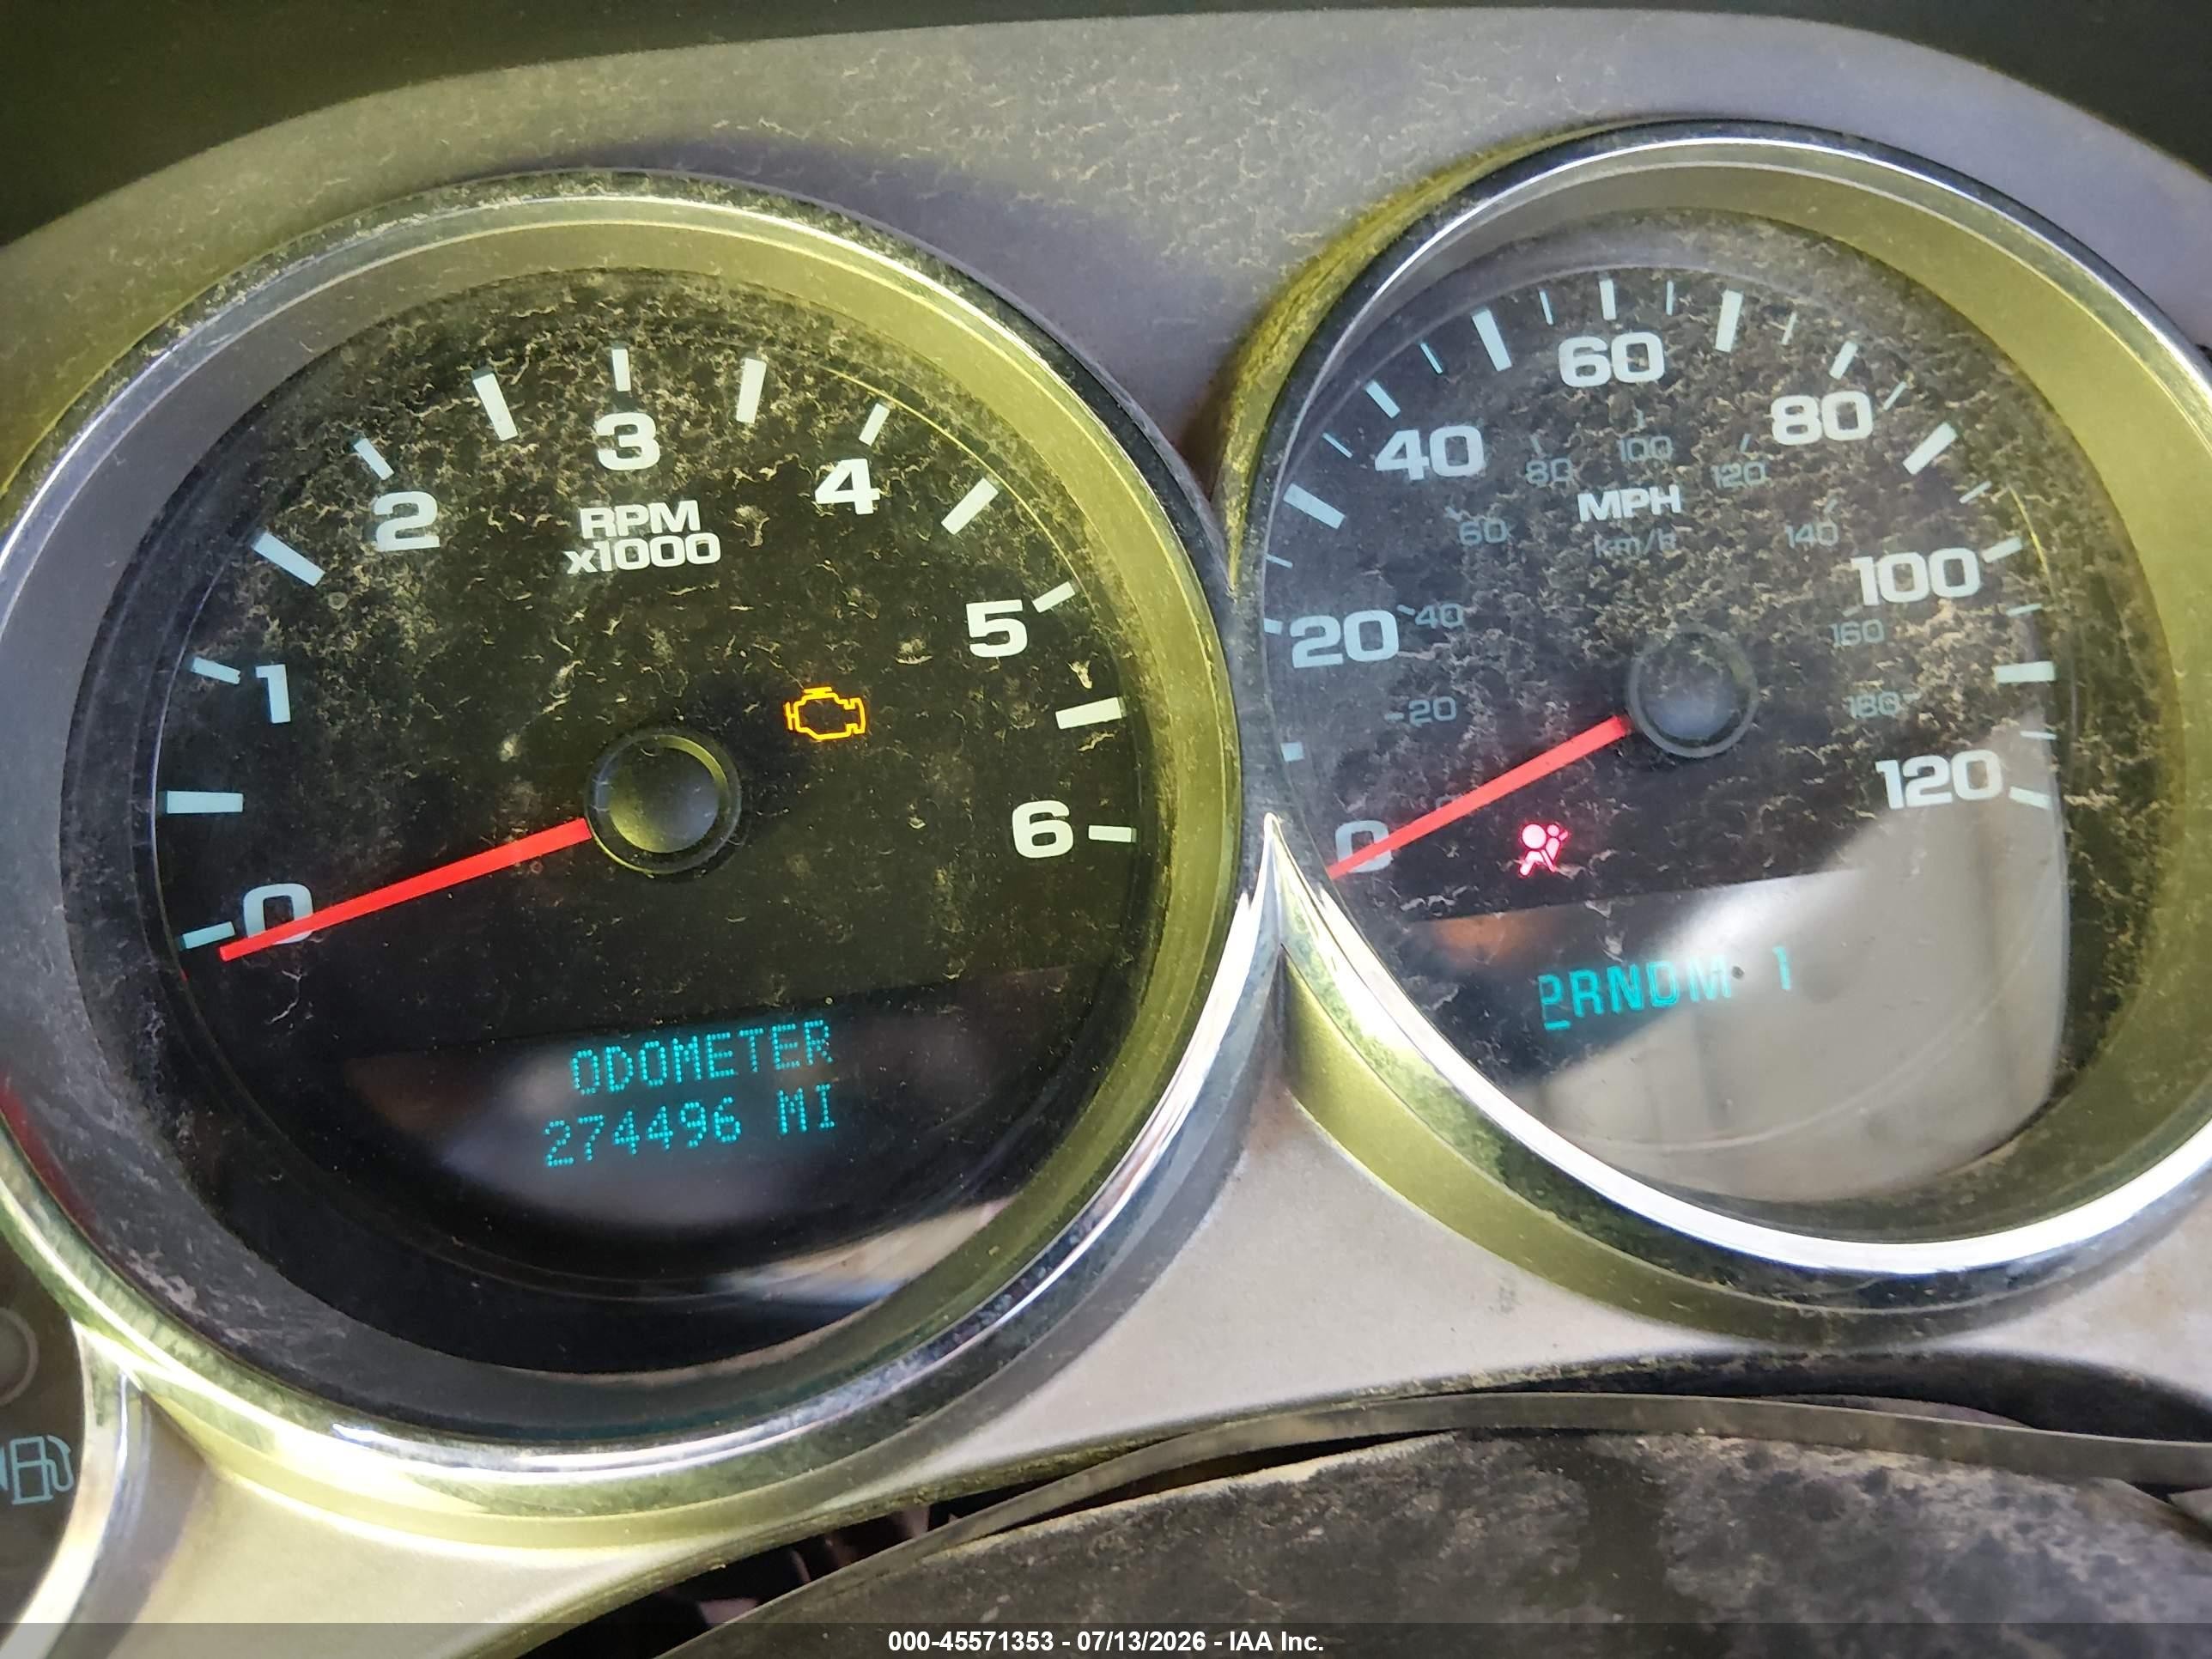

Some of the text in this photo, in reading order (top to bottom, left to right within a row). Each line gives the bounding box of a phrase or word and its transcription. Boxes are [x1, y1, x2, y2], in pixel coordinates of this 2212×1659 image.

[1559, 331, 1665, 387] 60
[597, 412, 660, 471] 3
[1771, 390, 1873, 446] 80
[1375, 425, 1486, 480] 40
[1526, 458, 1574, 488] 80
[1617, 435, 1674, 464] 100
[1711, 460, 1767, 489] 120
[814, 458, 880, 514] 4
[1577, 484, 1681, 522] MPH
[372, 491, 441, 552] 2
[580, 500, 702, 539] RPM
[1459, 520, 1510, 545] 60
[1593, 528, 1677, 559] km/h
[1784, 520, 1839, 549] 140
[566, 533, 721, 575] x1000
[1850, 547, 1980, 605] 100
[966, 599, 1028, 658] 5
[1290, 608, 1399, 668] 20
[1414, 604, 1463, 629] 40
[1829, 618, 1885, 647] 160
[257, 664, 291, 724] 1
[1408, 696, 1457, 728] 20
[1848, 690, 1902, 720] 180
[1875, 750, 2002, 810] 120
[1012, 800, 1073, 858] 6
[1335, 820, 1392, 872] 0
[243, 883, 314, 945] 0
[570, 1019, 834, 1096] ODOMETER
[544, 1084, 835, 1166] 274496 MI
